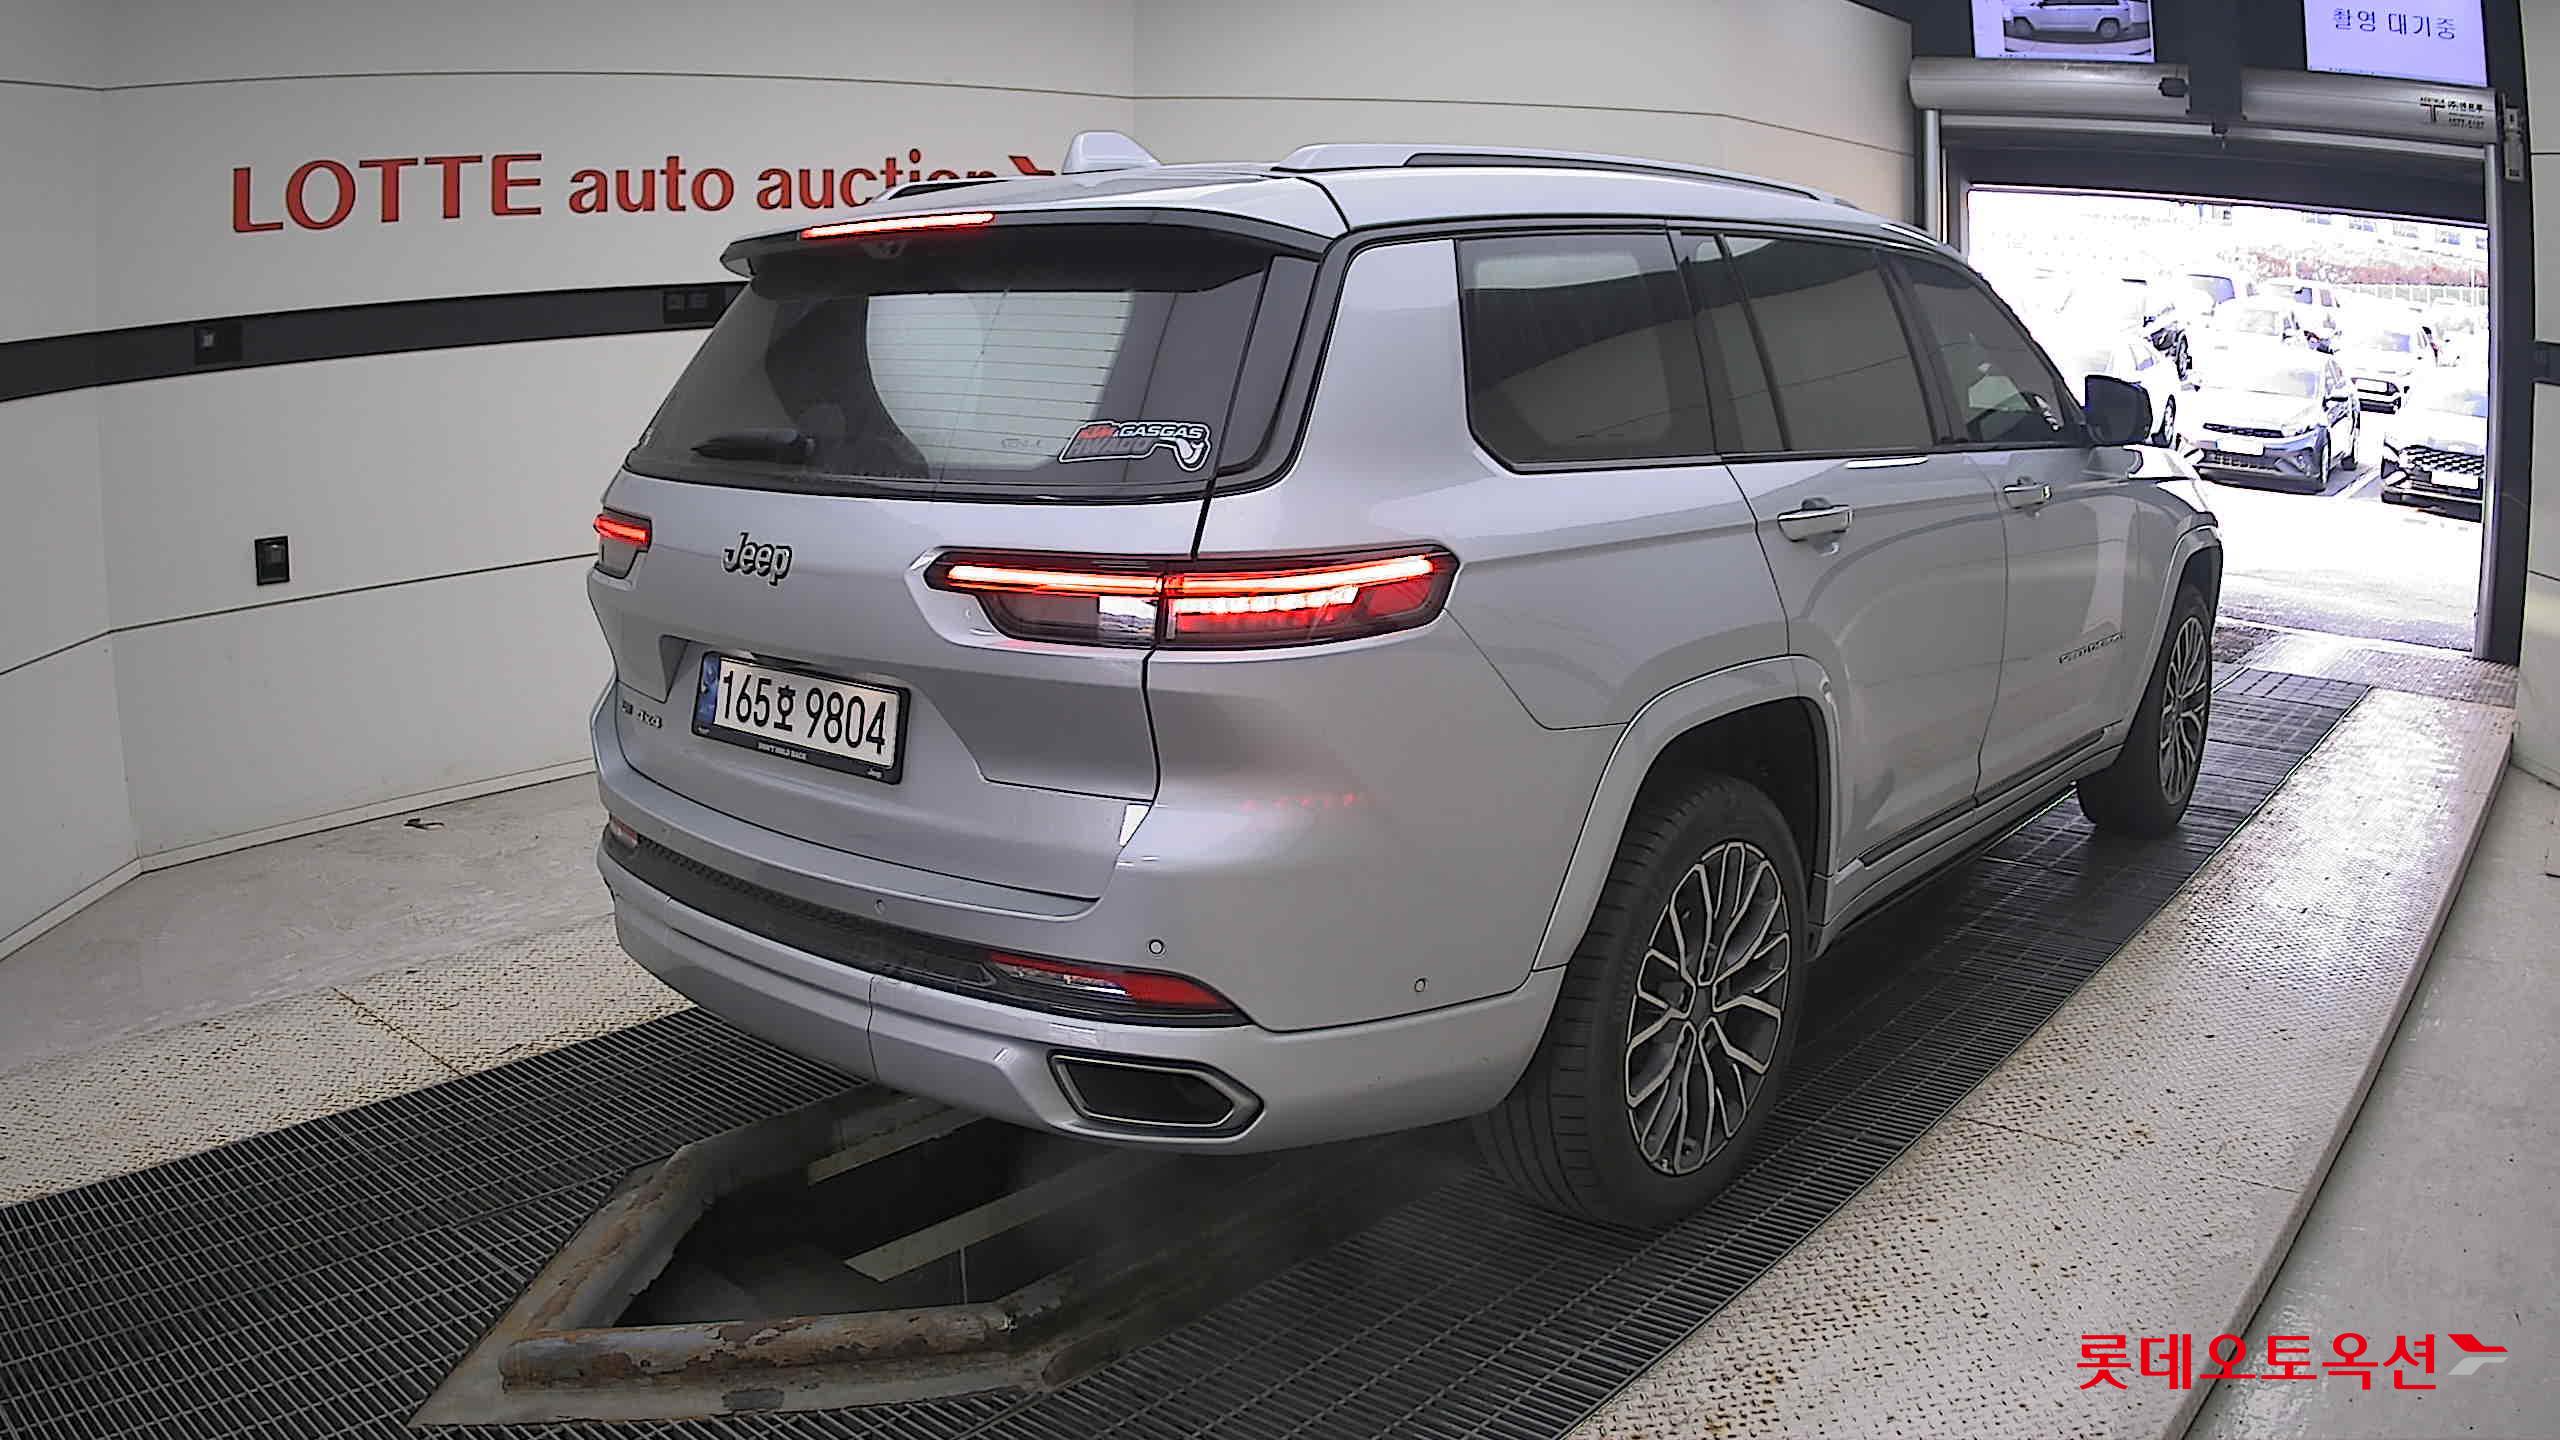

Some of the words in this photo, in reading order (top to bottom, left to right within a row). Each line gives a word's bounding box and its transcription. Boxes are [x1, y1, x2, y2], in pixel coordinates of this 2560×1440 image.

[2333, 8, 2377, 32] 촬영
[2388, 13, 2457, 40] 대기중
[233, 153, 542, 234] LOTTE
[568, 155, 735, 214] auto
[1119, 425, 1205, 439] GASGAS
[723, 531, 793, 587] Jeep
[722, 669, 797, 732] 165호
[804, 686, 886, 755] 9804
